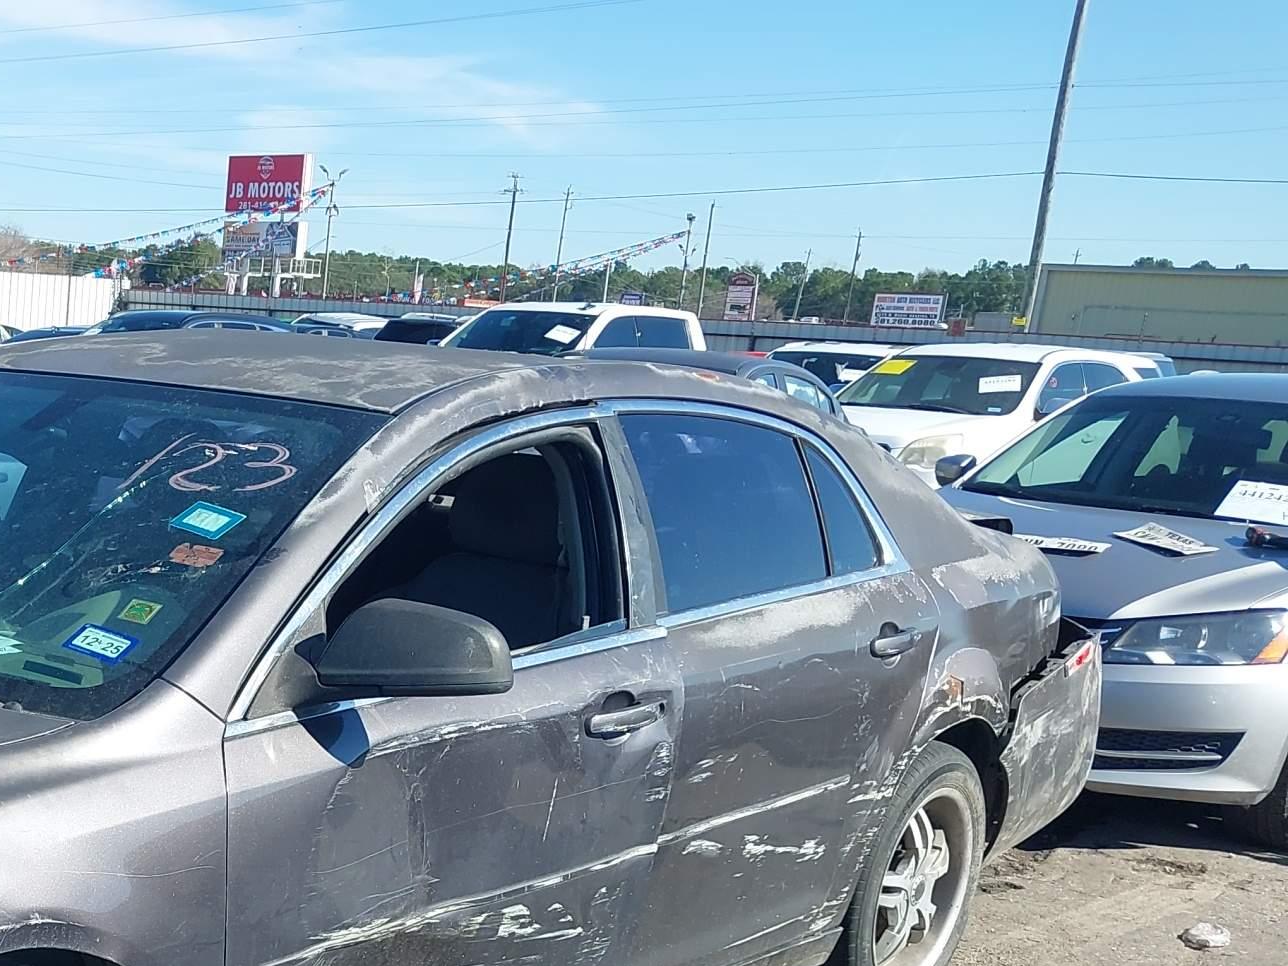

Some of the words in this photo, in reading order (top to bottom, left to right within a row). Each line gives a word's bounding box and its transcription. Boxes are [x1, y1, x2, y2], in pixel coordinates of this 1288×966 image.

[230, 182, 244, 198] JB
[248, 181, 300, 198] MOTORS
[116, 432, 298, 492] 123
[1165, 531, 1195, 546] TEXAS
[80, 635, 98, 647] 12
[100, 642, 123, 655] 25
